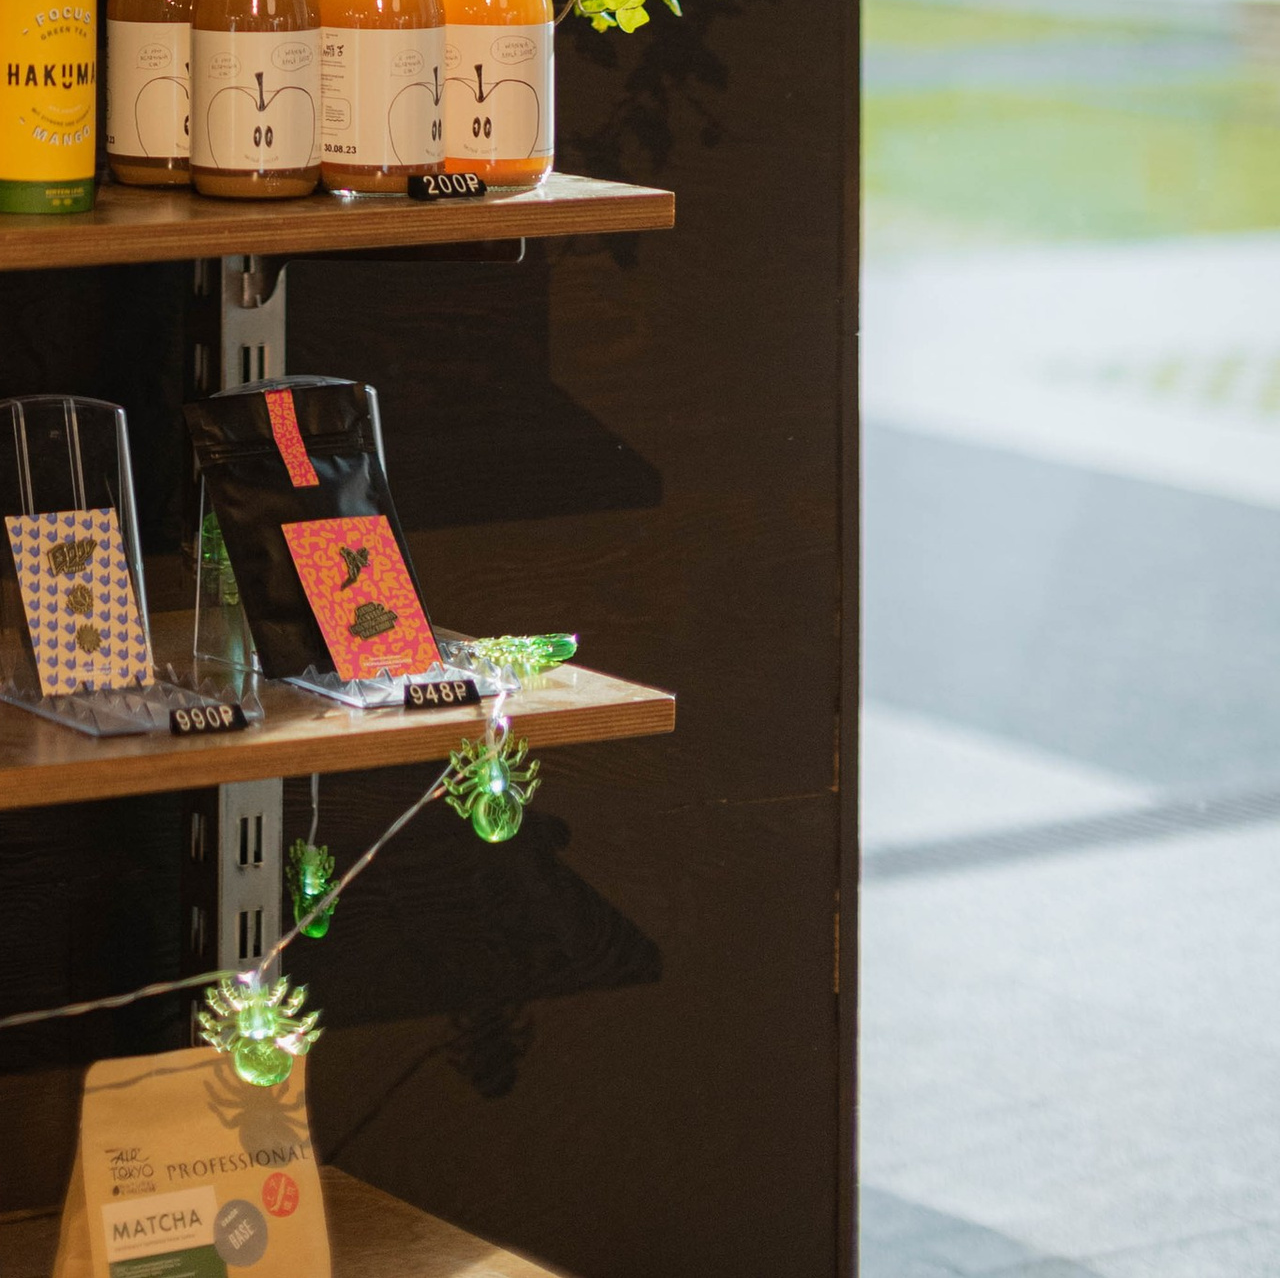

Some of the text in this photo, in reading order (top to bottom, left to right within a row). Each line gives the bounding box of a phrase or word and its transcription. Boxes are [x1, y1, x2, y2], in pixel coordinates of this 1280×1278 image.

[35, 6, 91, 27] FOCUS
[40, 26, 88, 41] GREEN TEA
[32, 125, 91, 147] MANGO
[324, 143, 357, 155] 30.08.23
[110, 1164, 154, 1182] TOKYO
[166, 1144, 309, 1182] PROFESSIONAL
[112, 1208, 203, 1242] MATCHA
[228, 1218, 255, 1251] BASE
